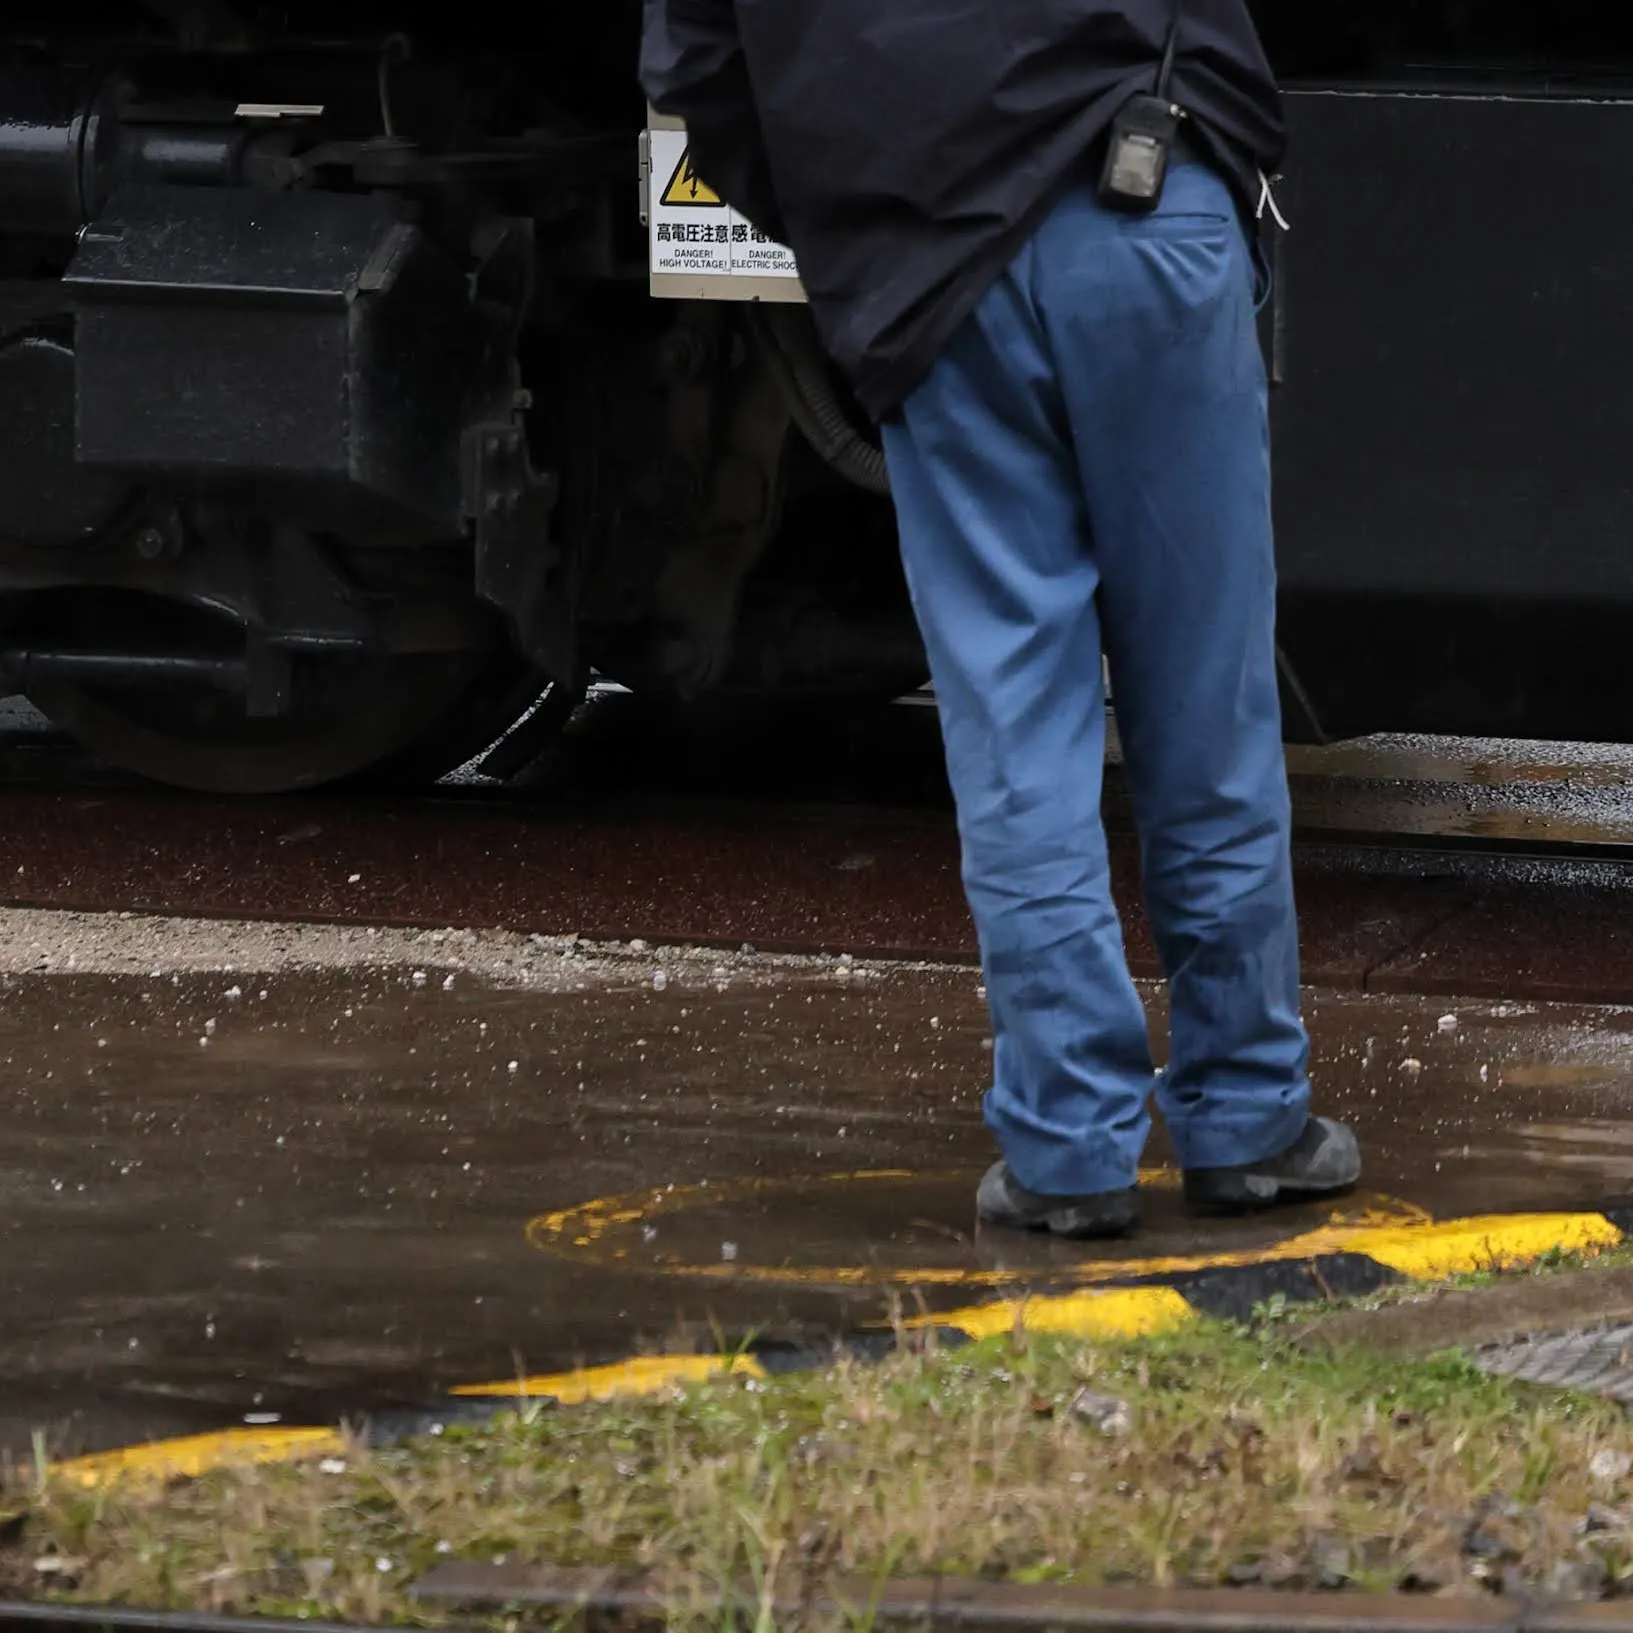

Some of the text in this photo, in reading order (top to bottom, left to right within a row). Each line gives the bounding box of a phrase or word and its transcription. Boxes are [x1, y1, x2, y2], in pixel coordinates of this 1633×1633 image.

[656, 223, 729, 243] 高電圧注意
[674, 249, 713, 258] DANGER!
[748, 249, 786, 259] DANGER!
[659, 258, 728, 269] HIGH VOLTAGE!
[731, 260, 770, 270] ELECTRIC
